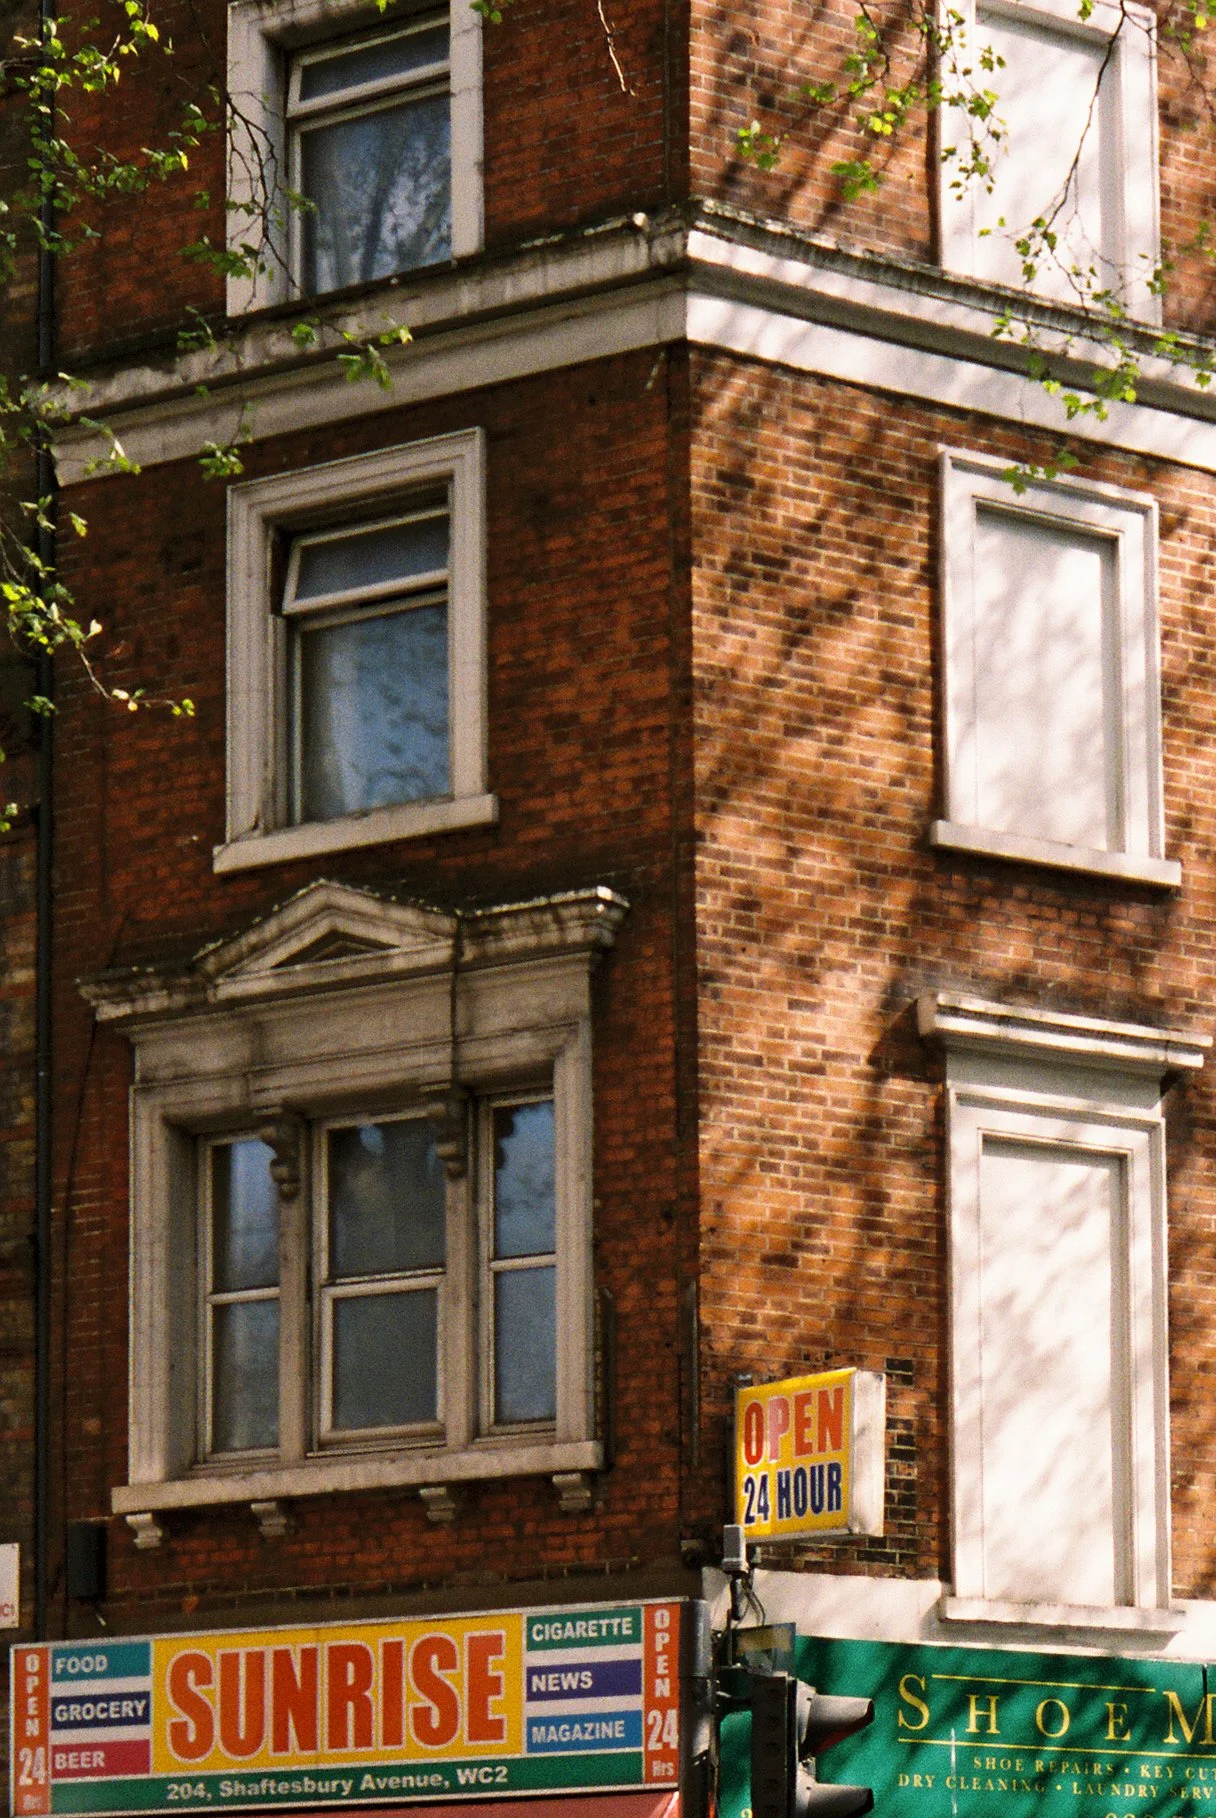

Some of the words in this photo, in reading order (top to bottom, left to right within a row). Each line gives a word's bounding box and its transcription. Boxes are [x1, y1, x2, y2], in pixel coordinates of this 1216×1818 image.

[744, 1386, 845, 1467] OPEN
[743, 1473, 770, 1525] 24
[777, 1462, 842, 1520] HOUR
[532, 1617, 633, 1642] CIGARETTE
[55, 1654, 108, 1675] FOOD
[654, 1608, 671, 1699] OPEN
[25, 1653, 40, 1737] OPEN
[166, 1630, 507, 1763] SUNRISE
[531, 1671, 593, 1692] NEWS
[54, 1700, 147, 1722] GROCERY
[532, 1720, 625, 1744] MAGAZINE
[647, 1708, 679, 1750] 24
[19, 1747, 47, 1786] 24
[54, 1751, 105, 1770] BEER
[973, 1756, 1025, 1771] SHOE
[1034, 1759, 1115, 1775] REPAIRS
[1139, 1764, 1175, 1779] KEY
[166, 1782, 213, 1801] 204,
[219, 1776, 353, 1797] Shaftesbury
[360, 1771, 450, 1790] Avenue,
[456, 1765, 509, 1785] WC2
[898, 1773, 936, 1789] DRY
[945, 1776, 1046, 1793] CLEANING
[1072, 1781, 1158, 1798] LAUNDRY
